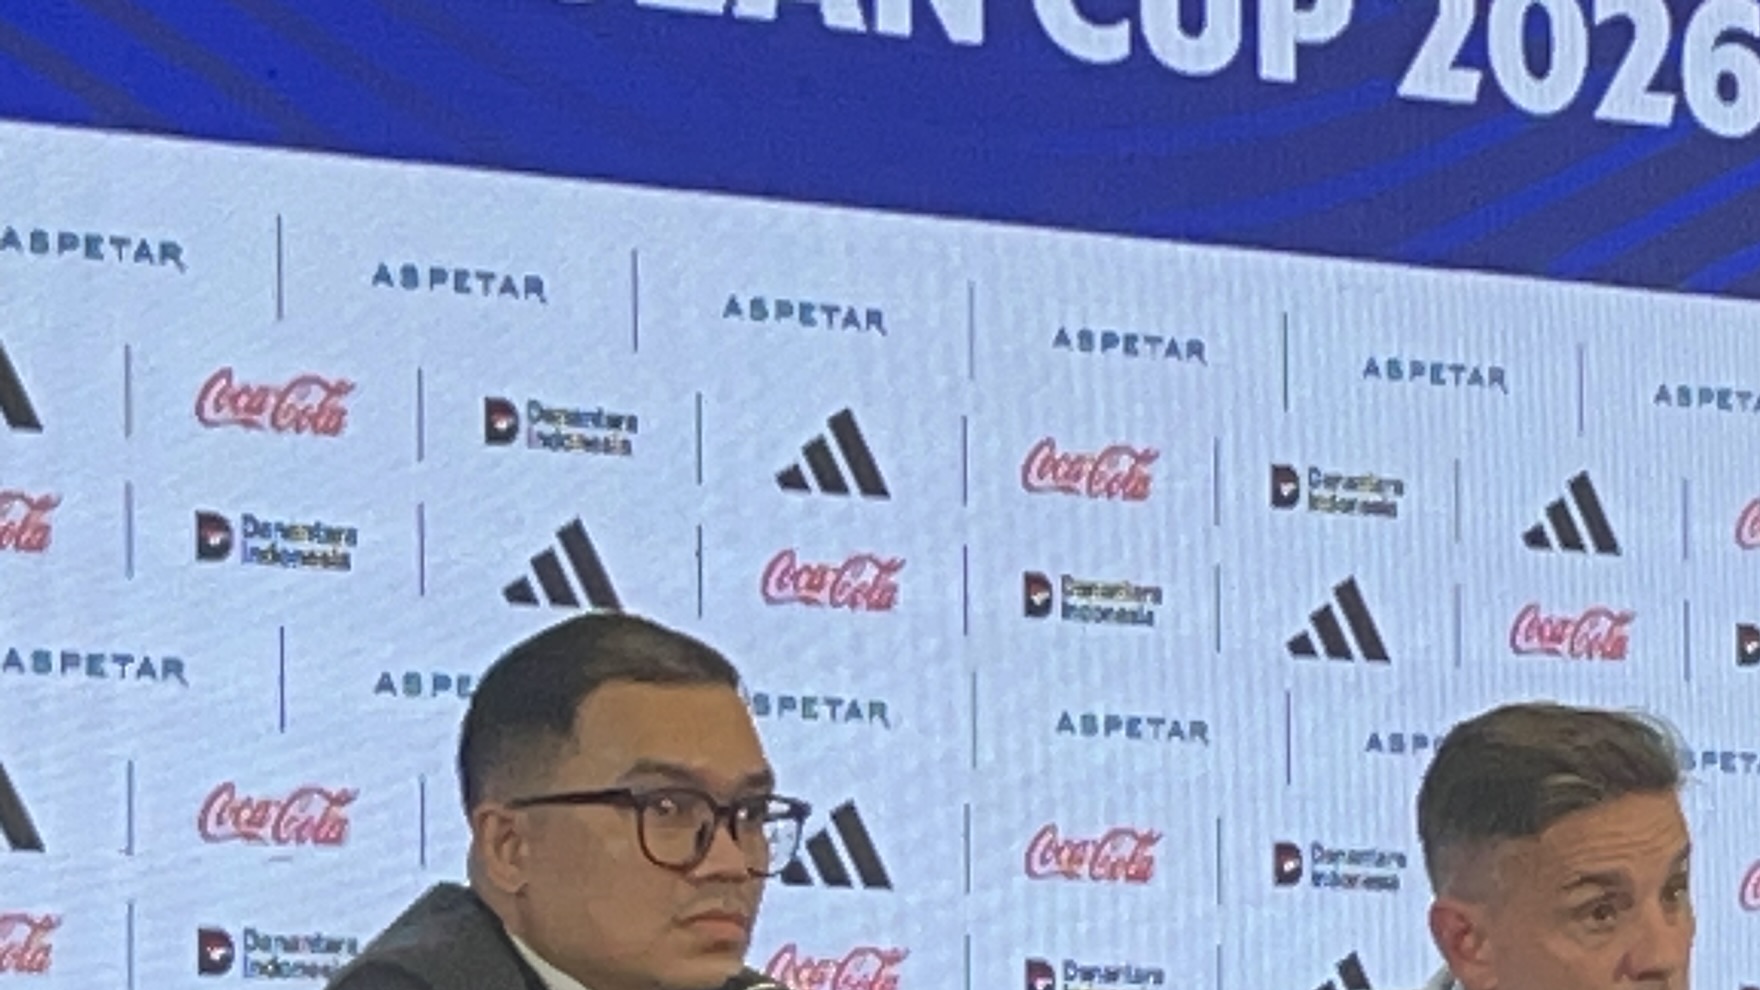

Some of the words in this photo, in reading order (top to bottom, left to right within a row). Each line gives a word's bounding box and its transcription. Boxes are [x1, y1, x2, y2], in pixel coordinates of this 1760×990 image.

[0, 226, 185, 273] ASPETAR
[372, 263, 547, 303] ASPETAR
[723, 294, 887, 336] ASPETAR
[1053, 326, 1207, 366] ASPETAR
[1363, 357, 1508, 395] ASPETAR
[2, 648, 188, 687] ASPETAR
[374, 672, 471, 703] ASPE
[748, 692, 890, 732] SPETAR
[1056, 711, 1209, 746] ASPETAR
